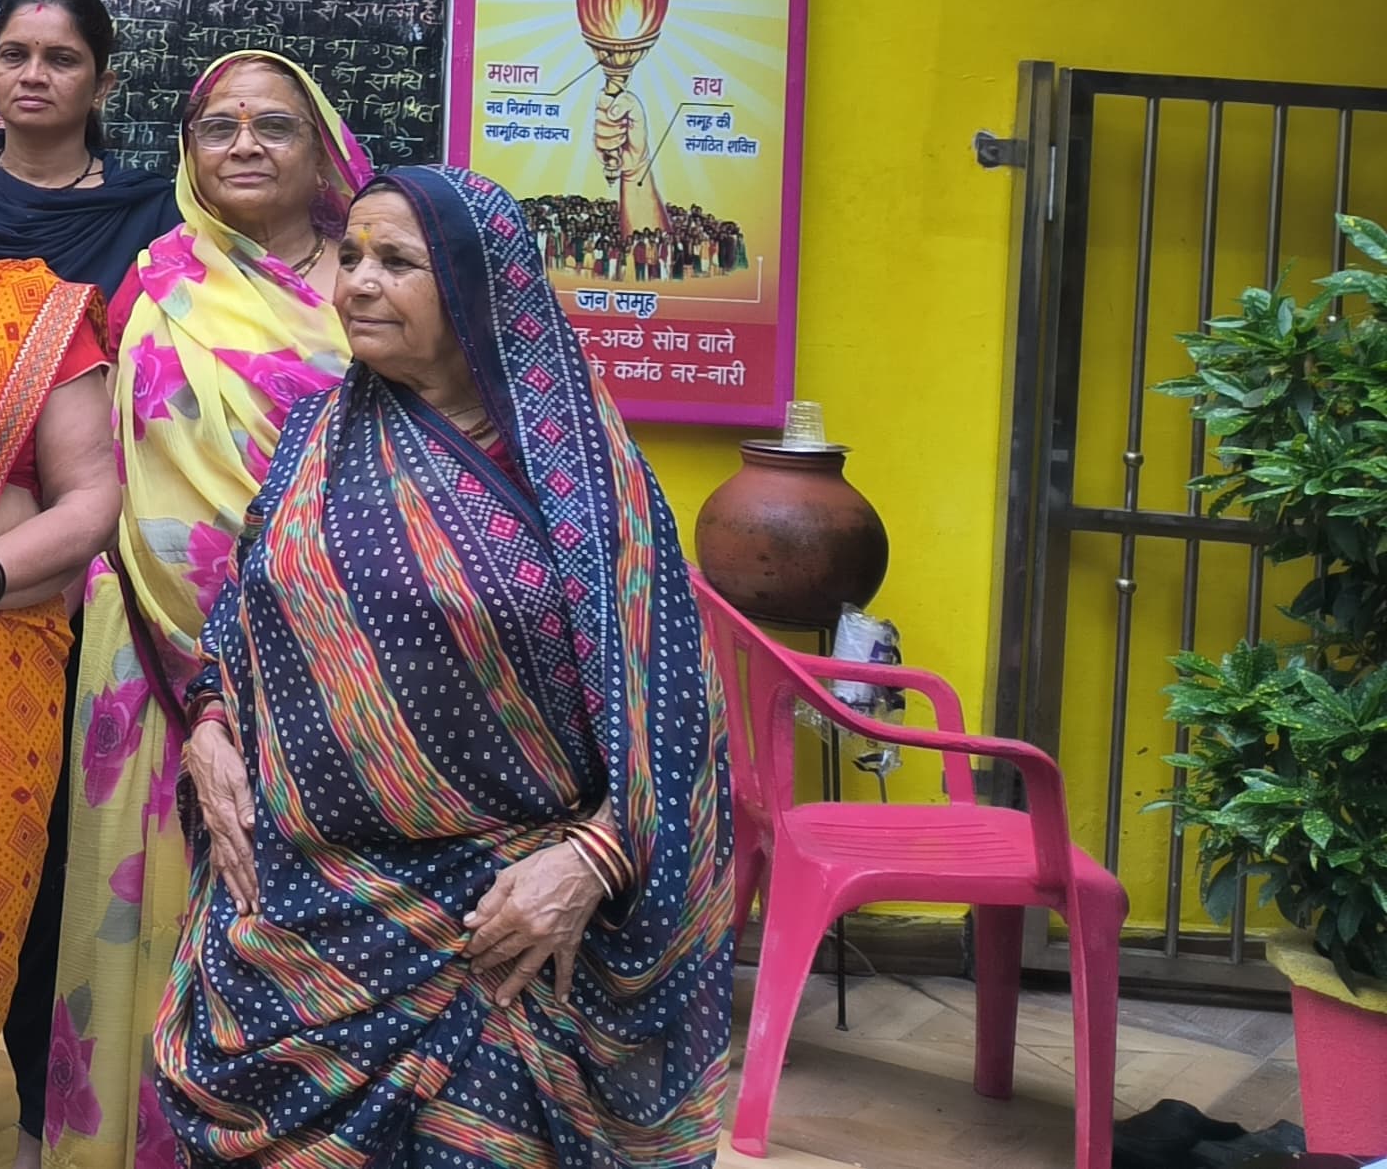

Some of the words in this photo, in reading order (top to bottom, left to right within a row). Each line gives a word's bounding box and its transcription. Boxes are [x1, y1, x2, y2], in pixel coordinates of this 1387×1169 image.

[487, 63, 540, 84] मशाल
[692, 77, 723, 96] हाथ
[486, 101, 503, 114] नव
[506, 98, 542, 116] निर्माण
[545, 104, 560, 118] का
[716, 112, 731, 129] की
[533, 124, 570, 141] संकल्प
[685, 135, 724, 152] संगठित
[577, 290, 609, 310] जन
[614, 291, 657, 317] समूह
[651, 325, 690, 352] सोच
[697, 329, 736, 354] वाले
[613, 357, 664, 381] कर्मठ
[670, 360, 746, 386] नर-नारी
